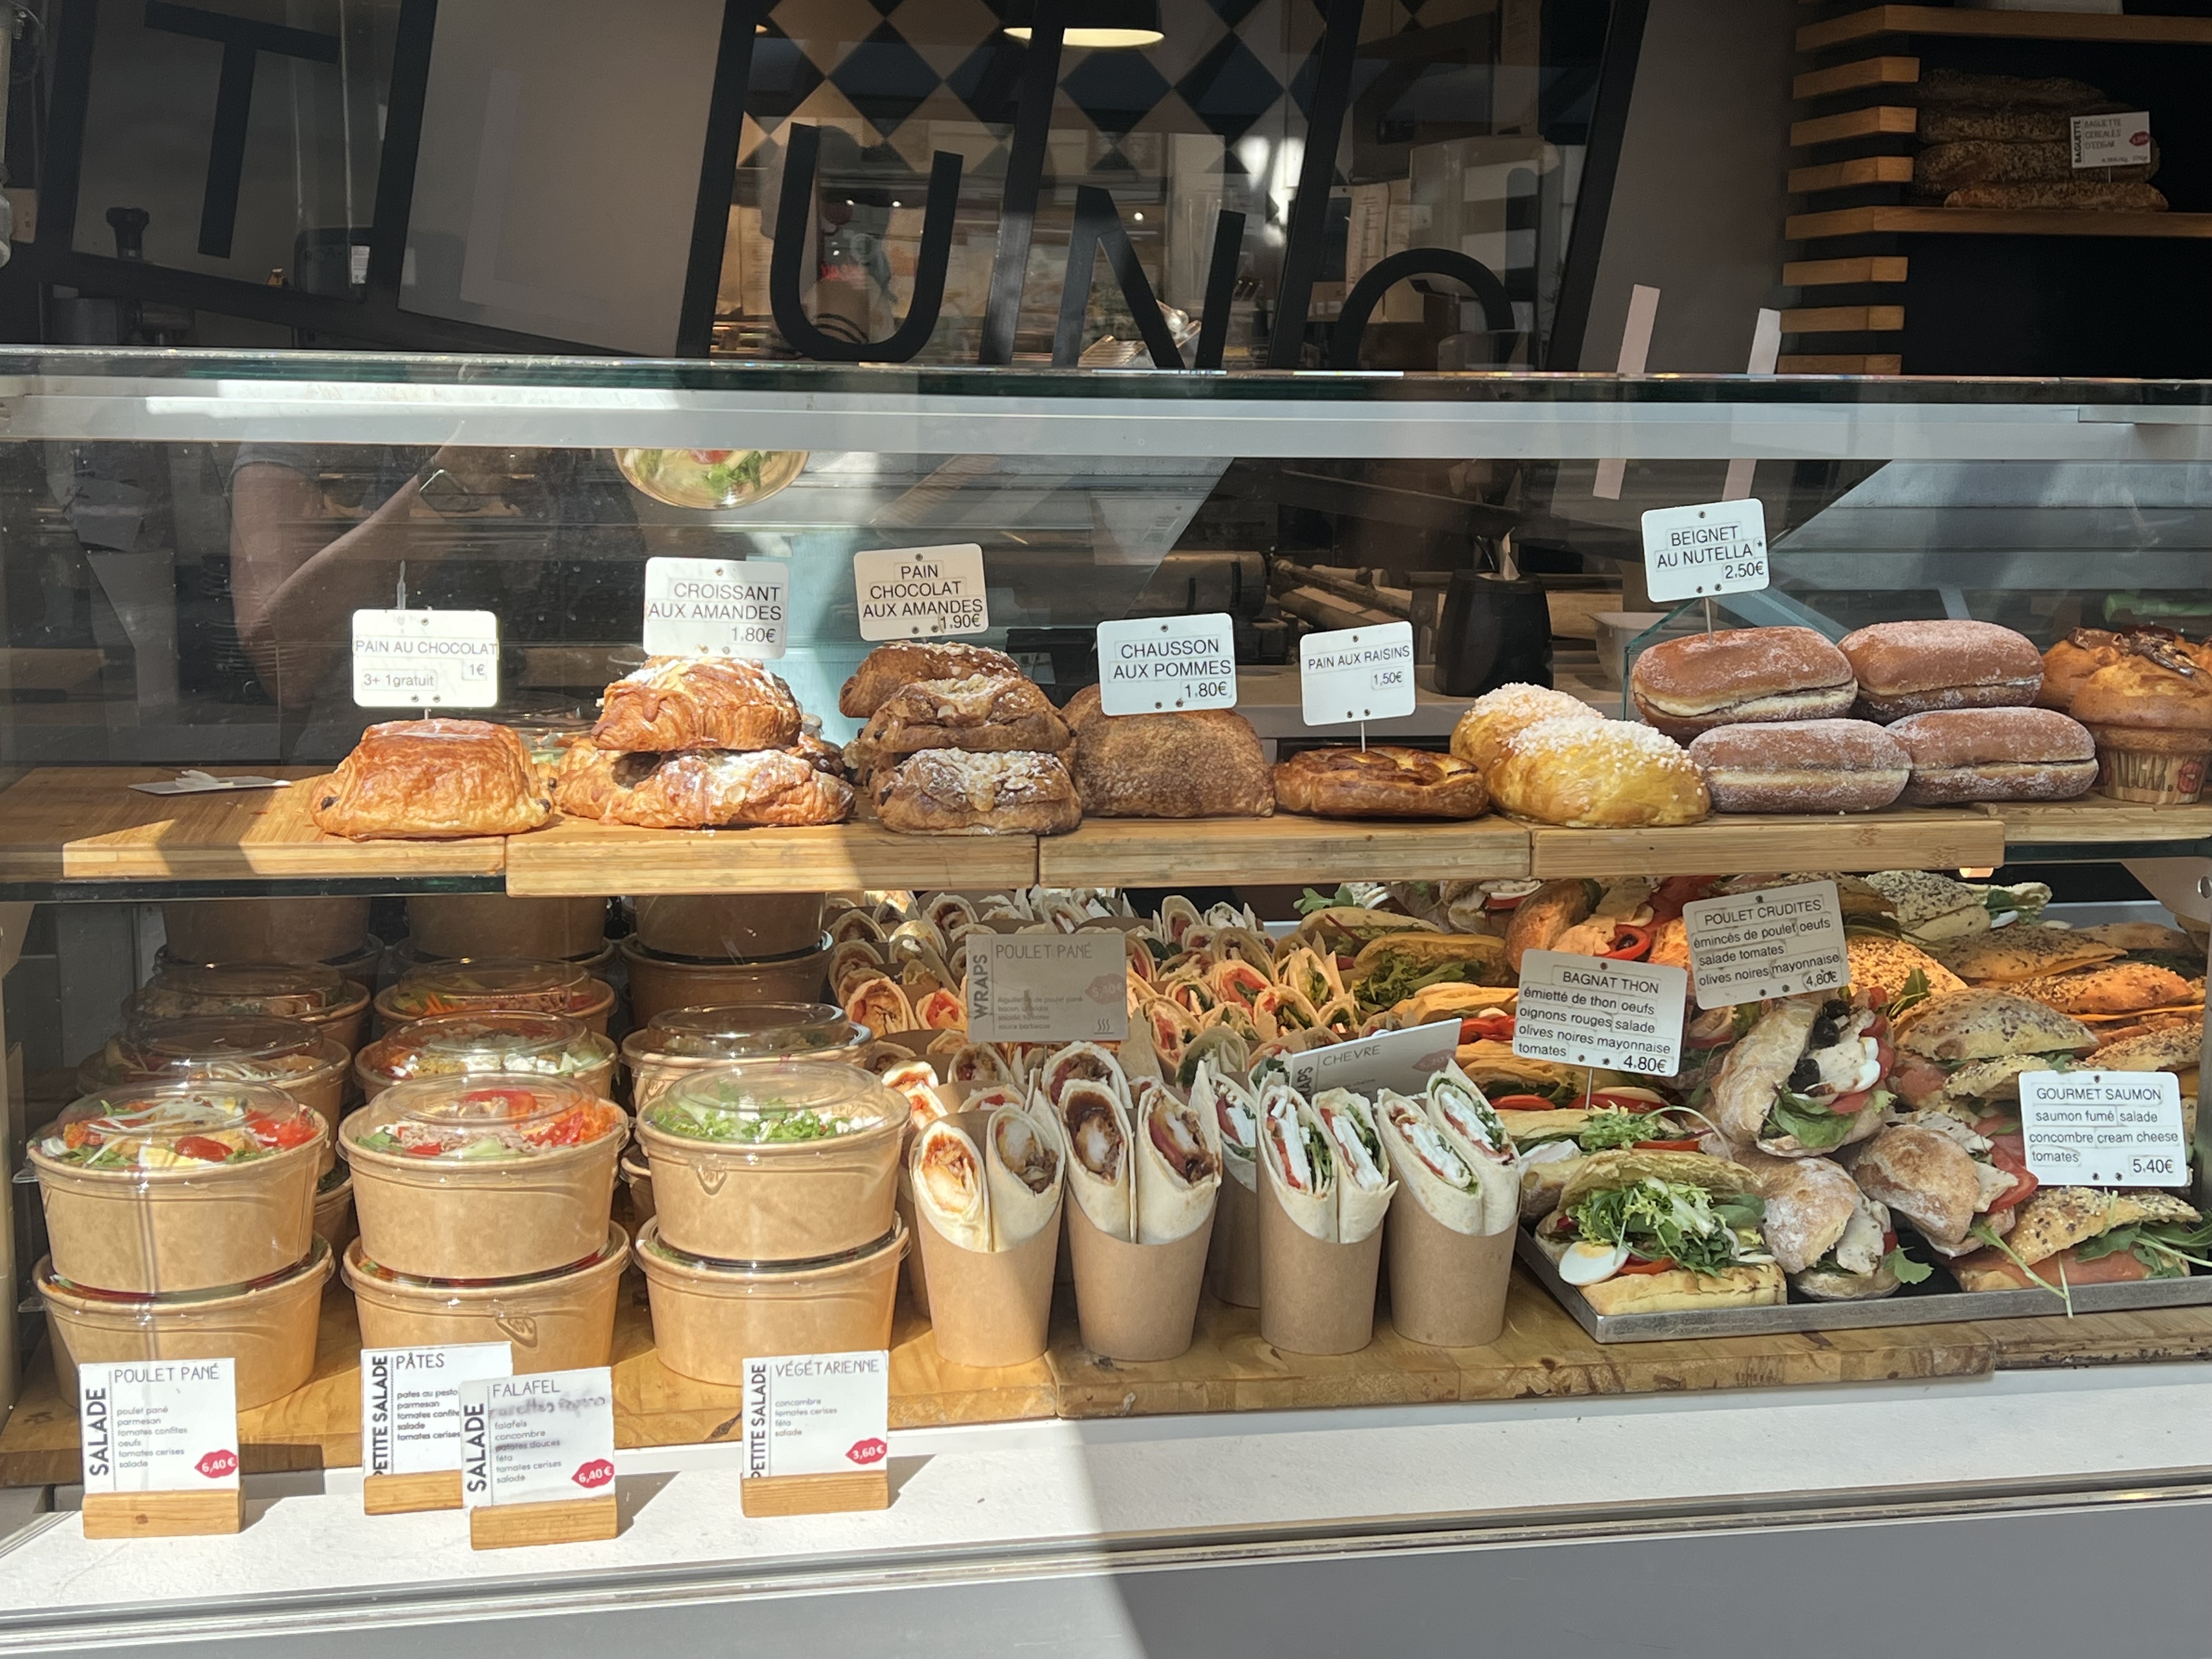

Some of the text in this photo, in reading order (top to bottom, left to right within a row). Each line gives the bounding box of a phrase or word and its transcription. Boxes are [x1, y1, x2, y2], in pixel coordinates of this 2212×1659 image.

[2074, 120, 2082, 163] BAGUETTE
[1671, 526, 1738, 546] BEIGNET
[1657, 552, 1678, 568] AU
[901, 564, 939, 580] PAIN
[674, 583, 781, 602] CROISSANT
[870, 580, 961, 600] CHOCOLAT
[648, 602, 782, 620] AUX AMANDES
[863, 599, 983, 618] AUX AMANDES
[732, 627, 776, 643] 1,80€
[356, 640, 497, 654] PAIN AU CHOCOLAT
[1121, 639, 1219, 659] CHAUSSON
[1308, 645, 1410, 671] PAIN AUX RAISINS
[469, 663, 485, 676] 1€
[1113, 660, 1232, 679] AUX POMMES
[1373, 671, 1403, 687] 1,50€
[1185, 681, 1228, 698] 1,80€
[1705, 899, 1822, 926] POULET CRUDITES
[1694, 918, 1831, 949] émincés de poulet oeufs
[996, 941, 1092, 959] POULET PANÉ
[1699, 945, 1785, 967] salade tomates
[1699, 953, 1840, 986] olives noires mayonnaise
[973, 954, 989, 1020] WRAPS
[1563, 971, 1659, 994] BAGNAT THON
[1523, 988, 1655, 1015] émietté de thon oeufs
[1519, 1007, 1655, 1033] oignons rouges salade
[1519, 1024, 1671, 1054] olives noires mayonnaise
[1322, 1045, 1381, 1067] CHEVRE
[1519, 1042, 1567, 1056] tomates
[1623, 1054, 1667, 1073] 4,80€
[2036, 1088, 2162, 1101] GOURMET SAUMON
[2035, 1110, 2158, 1122] saumon fumé salade
[2029, 1131, 2179, 1143] concombre cream cheese
[2032, 1150, 2079, 1163] tomates
[2133, 1158, 2174, 1174] 5,40€
[396, 1352, 445, 1370] PÂTES
[114, 1363, 220, 1384] POULET PANÉ
[372, 1355, 388, 1423] SALADE
[435, 1389, 458, 1398] pesto
[493, 1379, 561, 1398] FALAFEL
[751, 1364, 766, 1427] SALADE
[397, 1401, 439, 1410] parmesan
[775, 1398, 821, 1407] concombre
[117, 1406, 169, 1417] poulet pané
[397, 1412, 431, 1420] tomates
[775, 1407, 838, 1417] tomates cerises
[117, 1418, 162, 1427] parmesan
[397, 1422, 426, 1430] salade
[494, 1420, 527, 1430] falafels
[86, 1387, 109, 1476] SALADE
[117, 1428, 153, 1437] tomates
[397, 1431, 460, 1441] tomates cerises
[494, 1430, 546, 1441] concombre
[775, 1429, 803, 1437] salade
[118, 1439, 142, 1448] oeufs
[464, 1403, 487, 1493] SALADE
[529, 1440, 561, 1449] douces
[119, 1447, 185, 1458] tomates cerises
[495, 1454, 513, 1463] féta
[119, 1460, 148, 1468] salade
[496, 1460, 562, 1472] tomates cerises
[496, 1474, 526, 1483] salade
